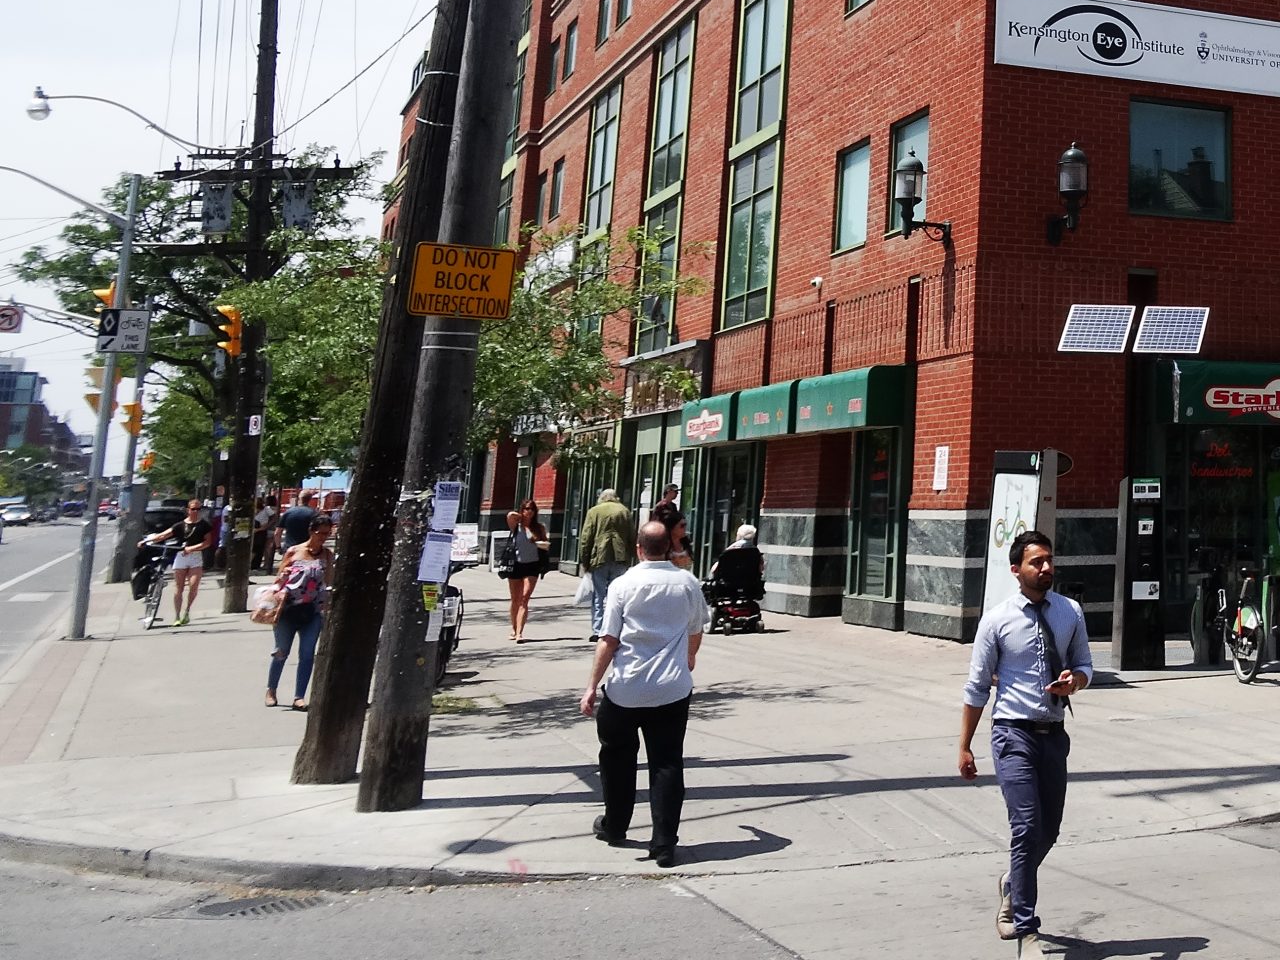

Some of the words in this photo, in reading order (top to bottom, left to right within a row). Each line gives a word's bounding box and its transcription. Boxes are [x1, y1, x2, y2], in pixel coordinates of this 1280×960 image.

[1008, 21, 1090, 43] Kensington
[1096, 32, 1124, 49] Eye
[1131, 37, 1185, 56] Institute
[1211, 43, 1255, 57] Ophthalmology
[1262, 50, 1280, 59] Vision
[1211, 53, 1266, 67] UNIVERSITY
[1269, 60, 1280, 68] OF
[432, 247, 458, 266] DO
[464, 250, 500, 270] NOT
[434, 271, 491, 292] BLOCK
[412, 292, 506, 316] INTERSECTION
[124, 334, 139, 342] THIS
[687, 418, 720, 432] Starbank
